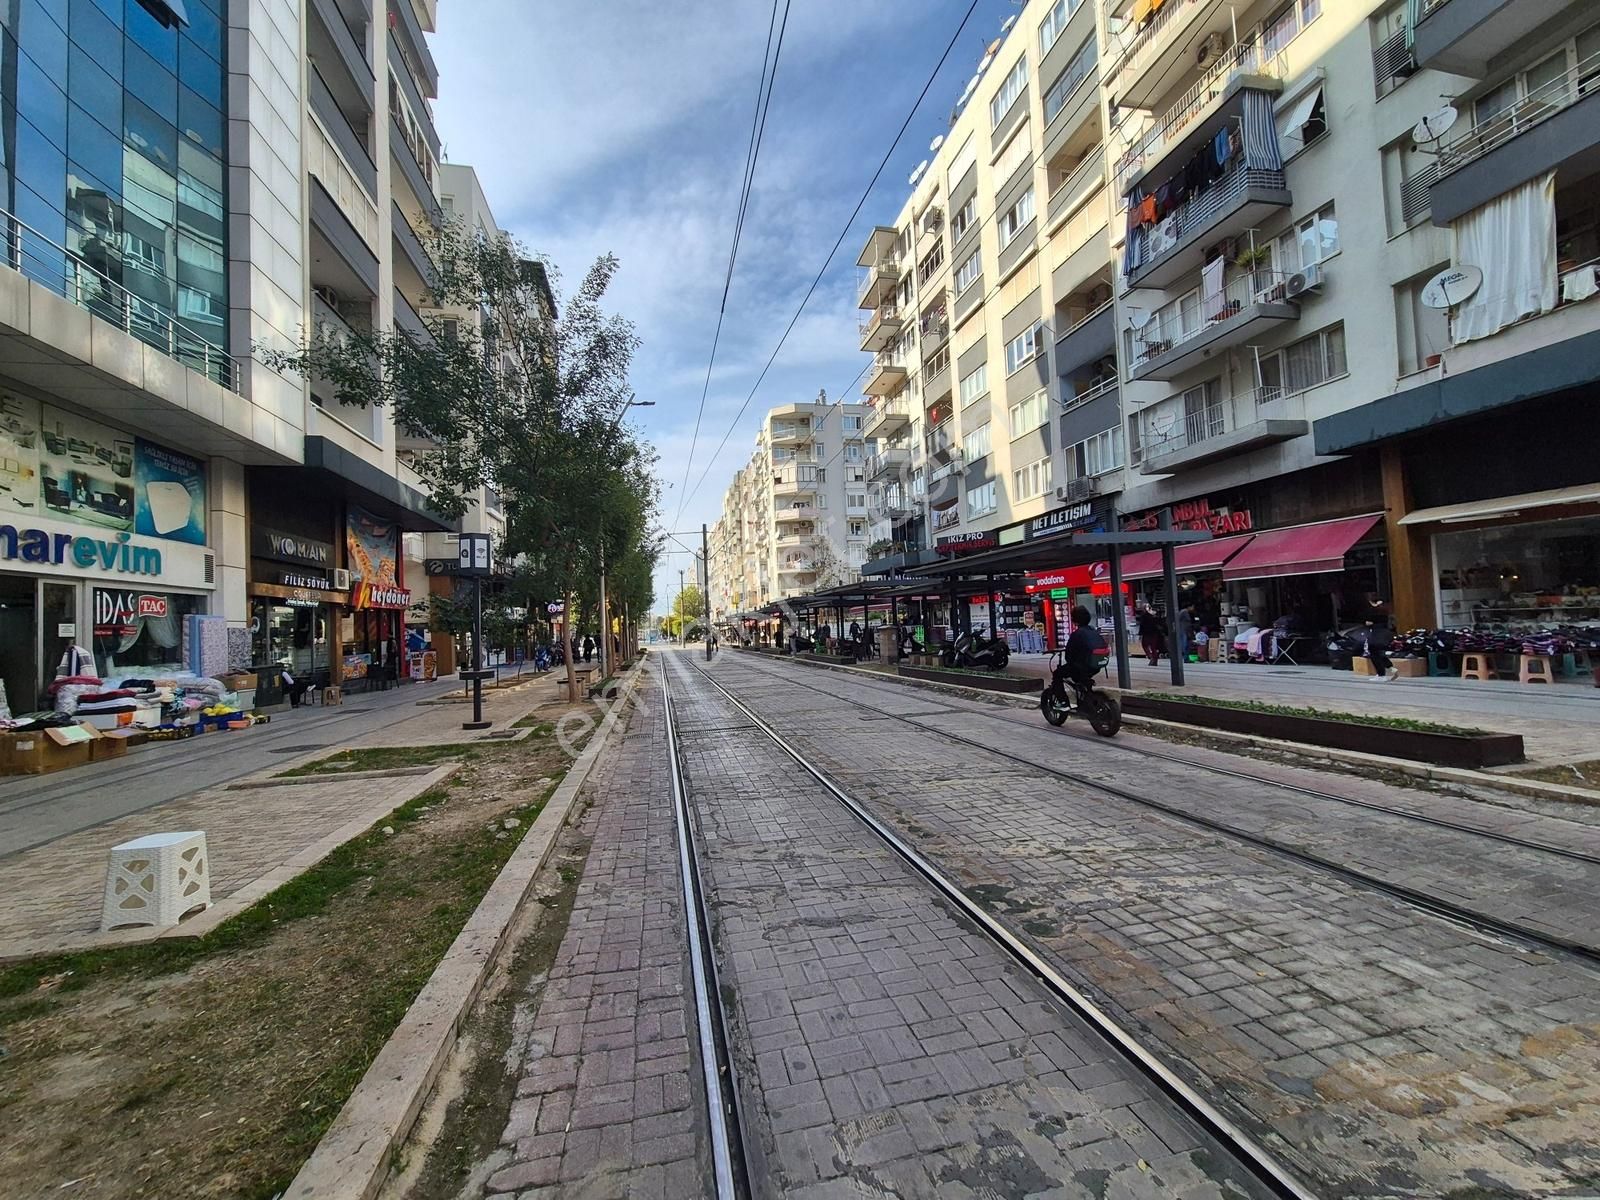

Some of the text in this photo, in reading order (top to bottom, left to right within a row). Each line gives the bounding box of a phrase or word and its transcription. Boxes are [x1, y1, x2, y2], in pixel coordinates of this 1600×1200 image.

[1032, 516, 1049, 531] NET
[1050, 502, 1092, 526] İLETİŞİM
[966, 532, 984, 541] PRO
[268, 533, 327, 562] WOMAN
[284, 572, 305, 587] FİLİZ
[1036, 575, 1065, 587] vodafone
[371, 585, 410, 606] heydöner
[141, 600, 165, 615] TAÇ
